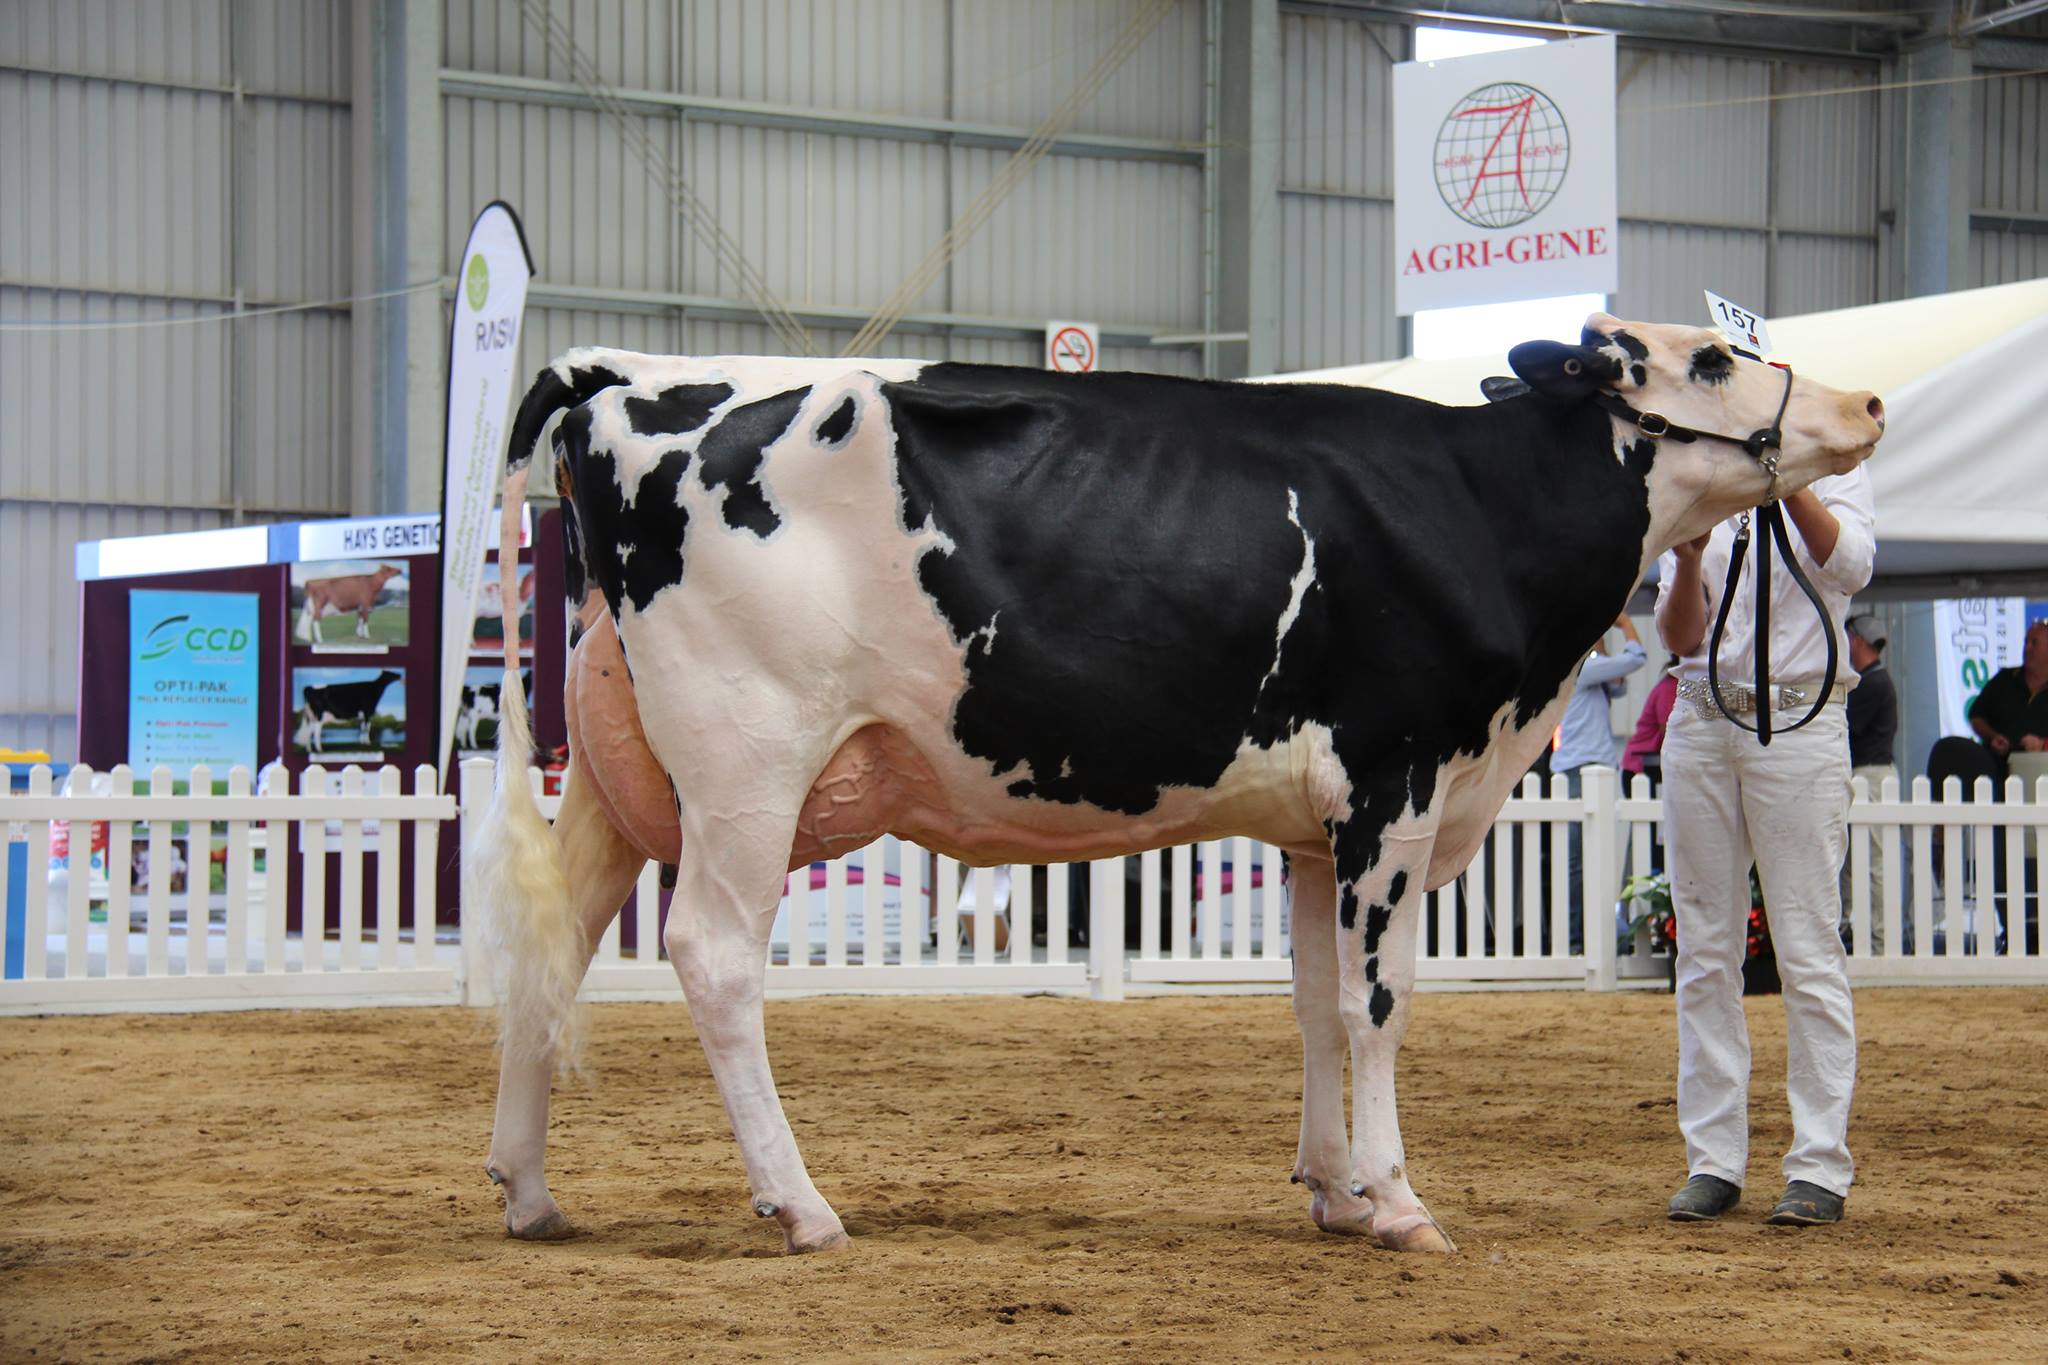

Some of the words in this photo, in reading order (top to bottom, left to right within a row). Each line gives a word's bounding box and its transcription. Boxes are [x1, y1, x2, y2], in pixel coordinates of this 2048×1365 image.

[1523, 143, 1563, 159] GENE
[1403, 226, 1608, 277] AGRI-GENE
[1718, 302, 1756, 334] 157
[475, 316, 516, 352] RASV
[344, 526, 377, 551] HAYS
[185, 627, 248, 651] CCD
[154, 680, 229, 692] OPTI-PAK
